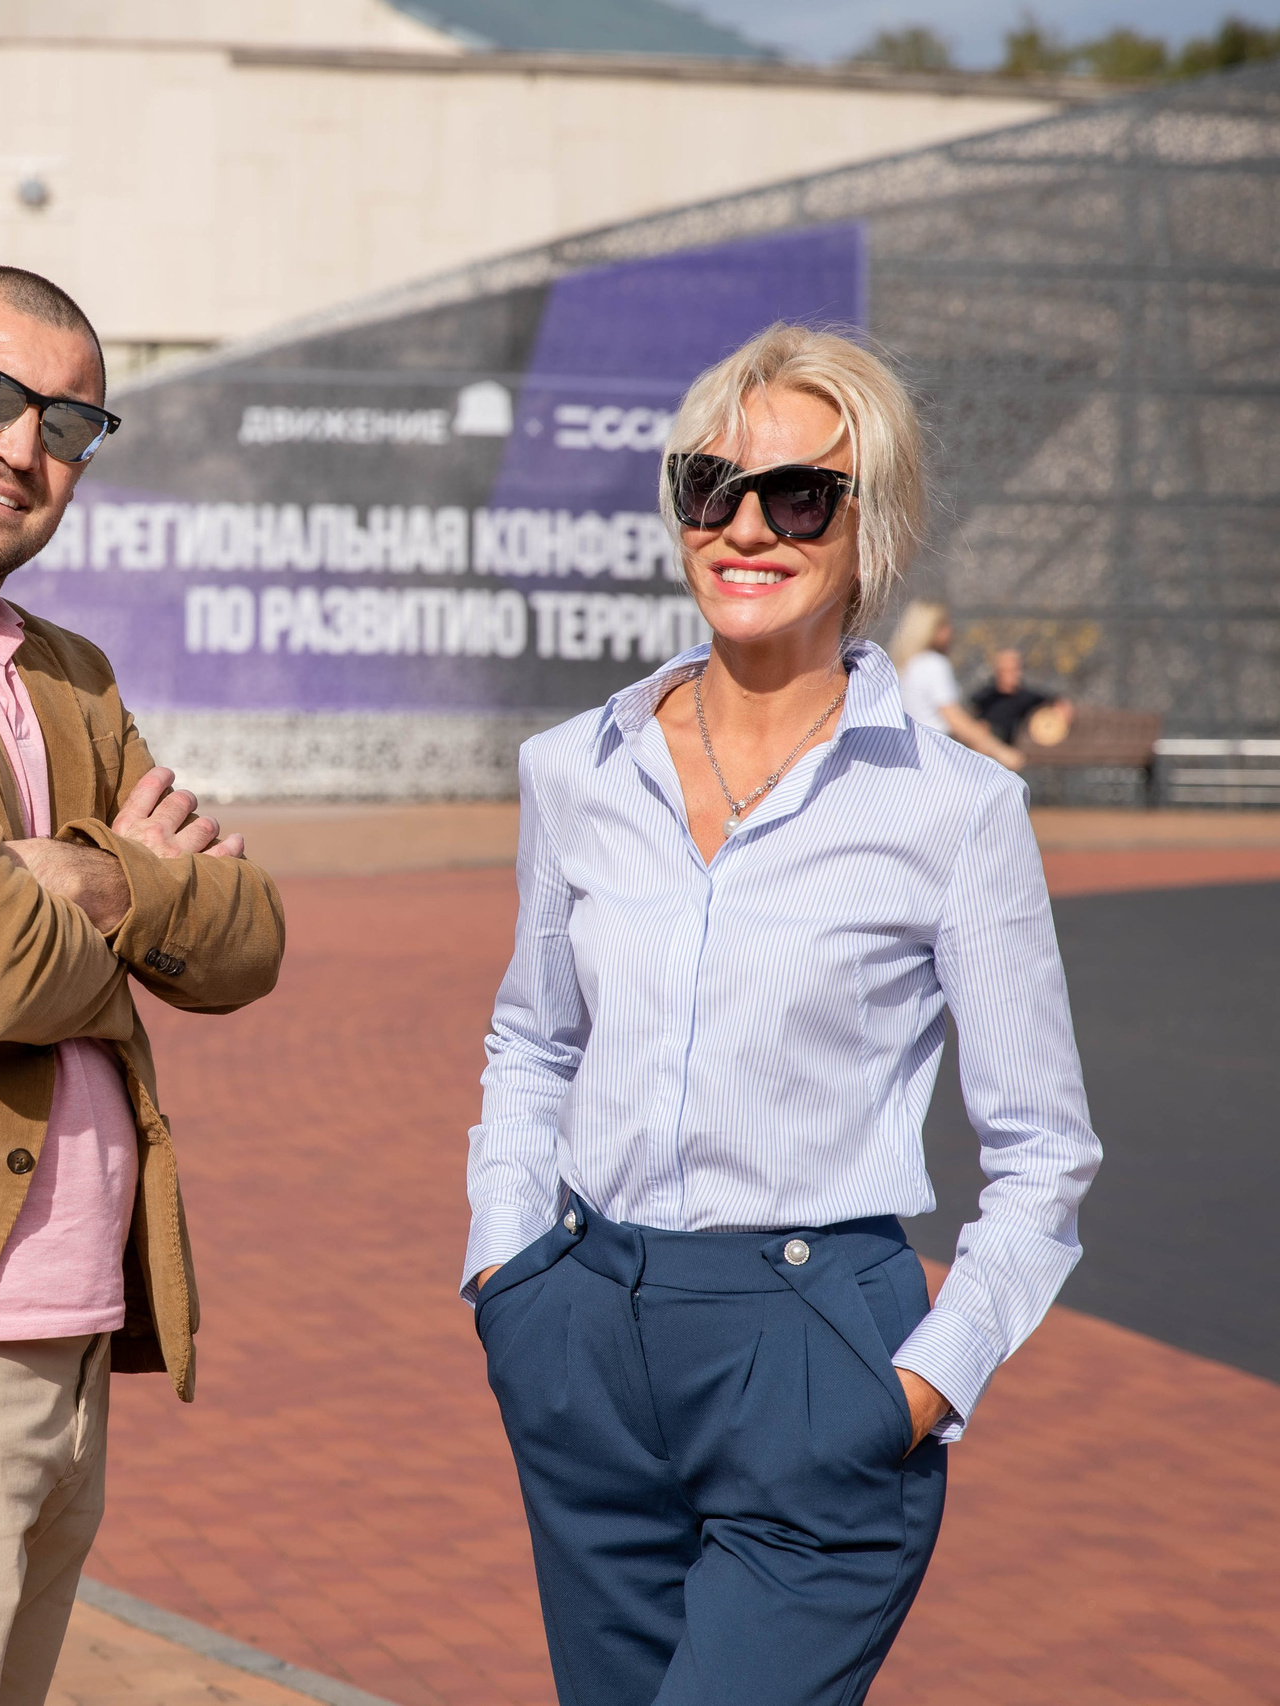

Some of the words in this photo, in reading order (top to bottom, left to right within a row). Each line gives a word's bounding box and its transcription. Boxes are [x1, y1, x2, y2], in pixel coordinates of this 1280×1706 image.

[91, 502, 472, 575] РЕГИОНАЛЬНАЯ
[184, 585, 258, 654] ПО
[261, 588, 527, 659] РАЗВИТИЮ
